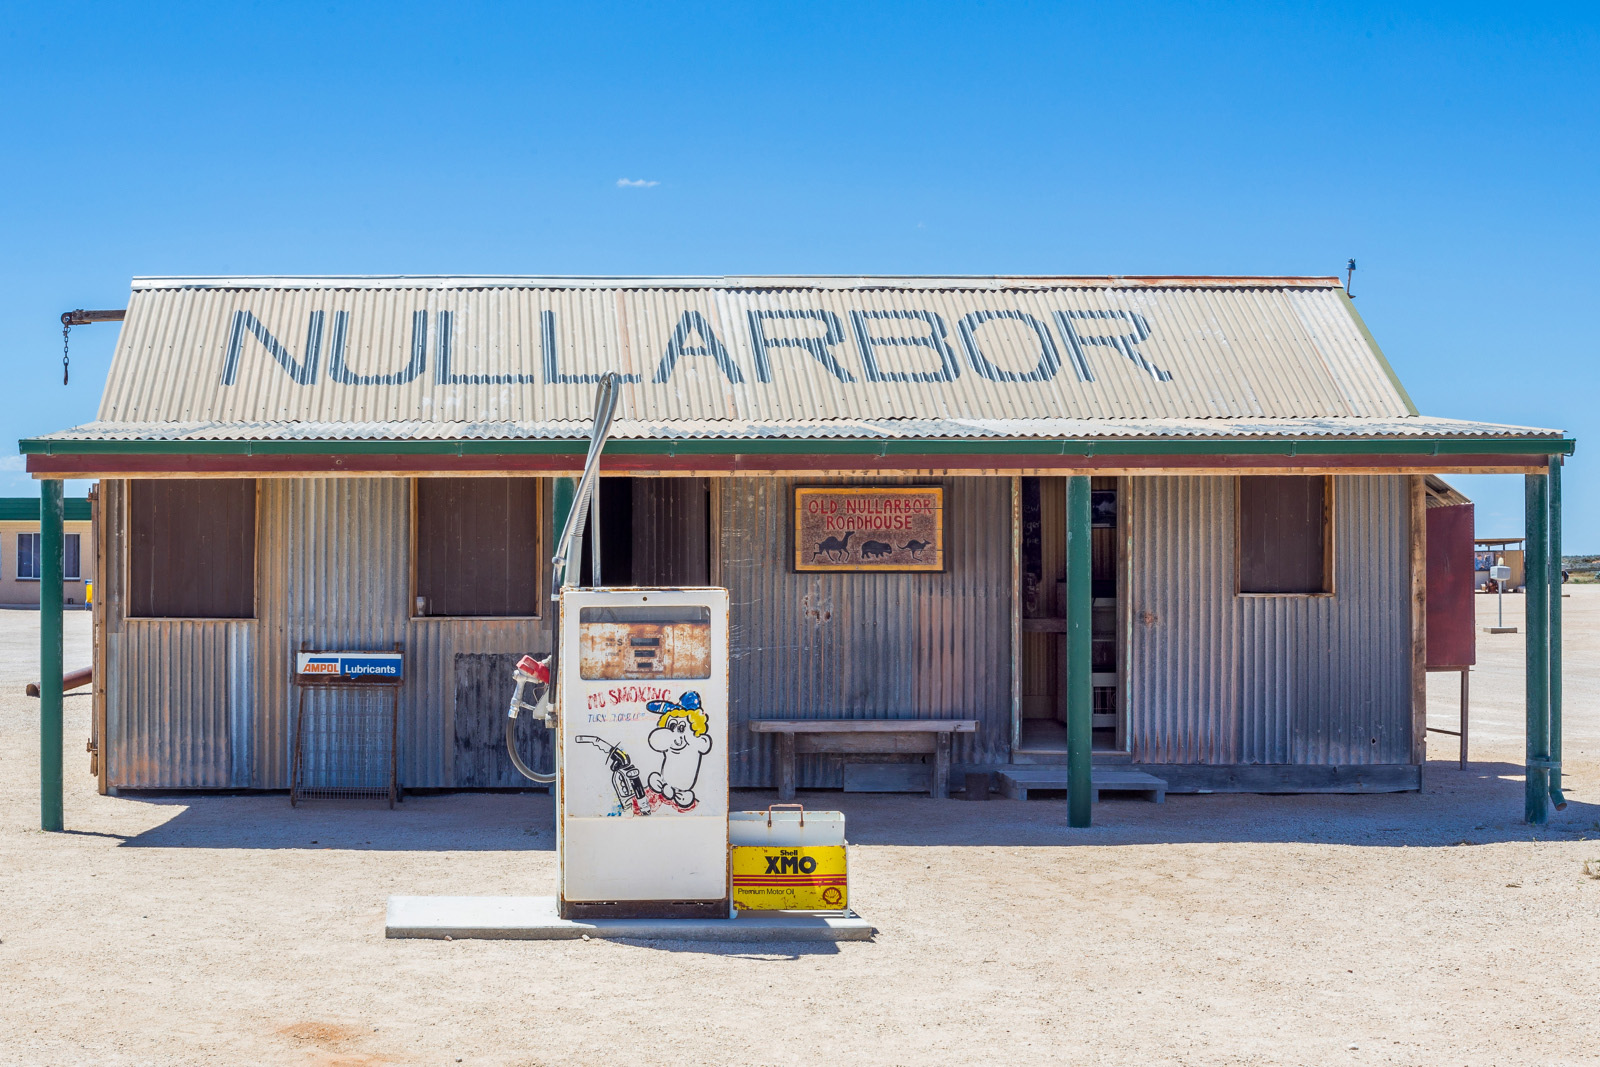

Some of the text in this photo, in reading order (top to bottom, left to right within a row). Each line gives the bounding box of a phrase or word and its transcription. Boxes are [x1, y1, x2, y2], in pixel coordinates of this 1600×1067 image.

[220, 309, 1173, 385] NULLARBOR
[808, 499, 932, 514] OLD NULLARBOR
[826, 515, 913, 530] ROADHOUSE
[302, 664, 396, 674] AMPOL Lubricants
[765, 856, 817, 874] XMO
